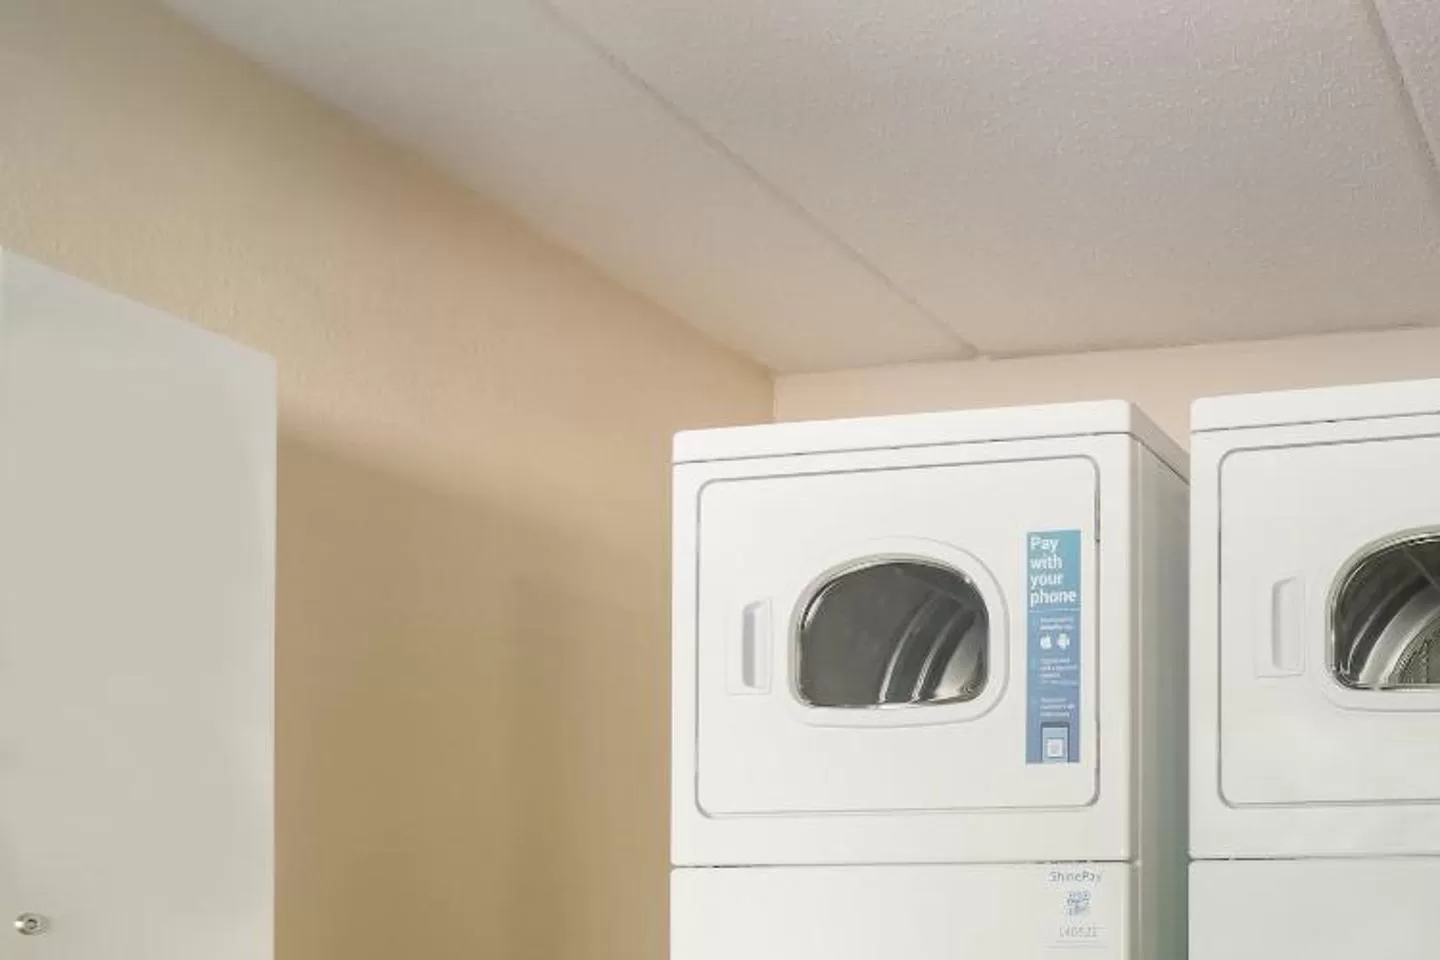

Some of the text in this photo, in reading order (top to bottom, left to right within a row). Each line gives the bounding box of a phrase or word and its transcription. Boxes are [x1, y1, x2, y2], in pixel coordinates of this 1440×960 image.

[1030, 535, 1061, 553] Pay
[1030, 553, 1063, 569] with
[1030, 573, 1065, 590] your
[1030, 588, 1077, 609] phone
[1047, 870, 1102, 886] ShinePay
